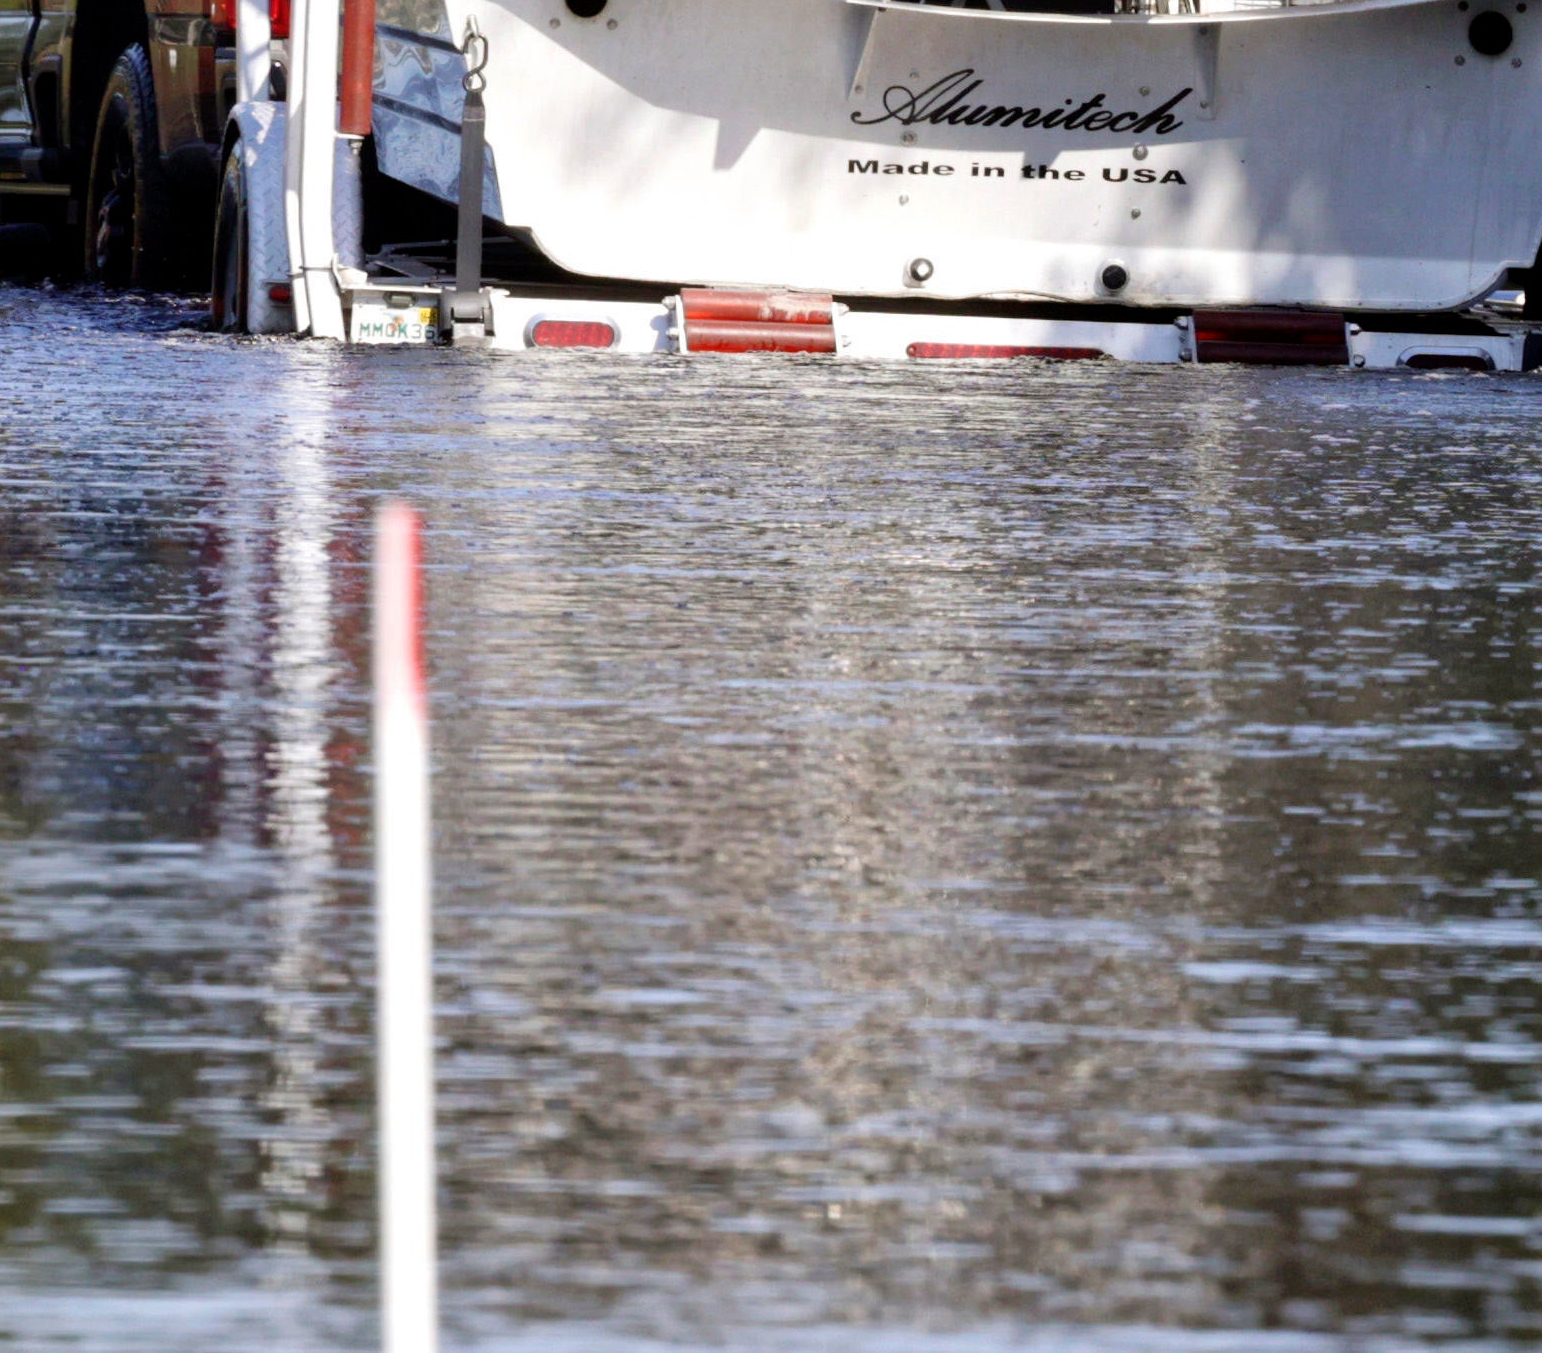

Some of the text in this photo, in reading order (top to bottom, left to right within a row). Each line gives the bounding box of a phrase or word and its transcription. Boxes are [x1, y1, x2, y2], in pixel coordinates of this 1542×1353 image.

[850, 67, 1194, 135] Alumitech
[847, 159, 1188, 186] Made in the USA
